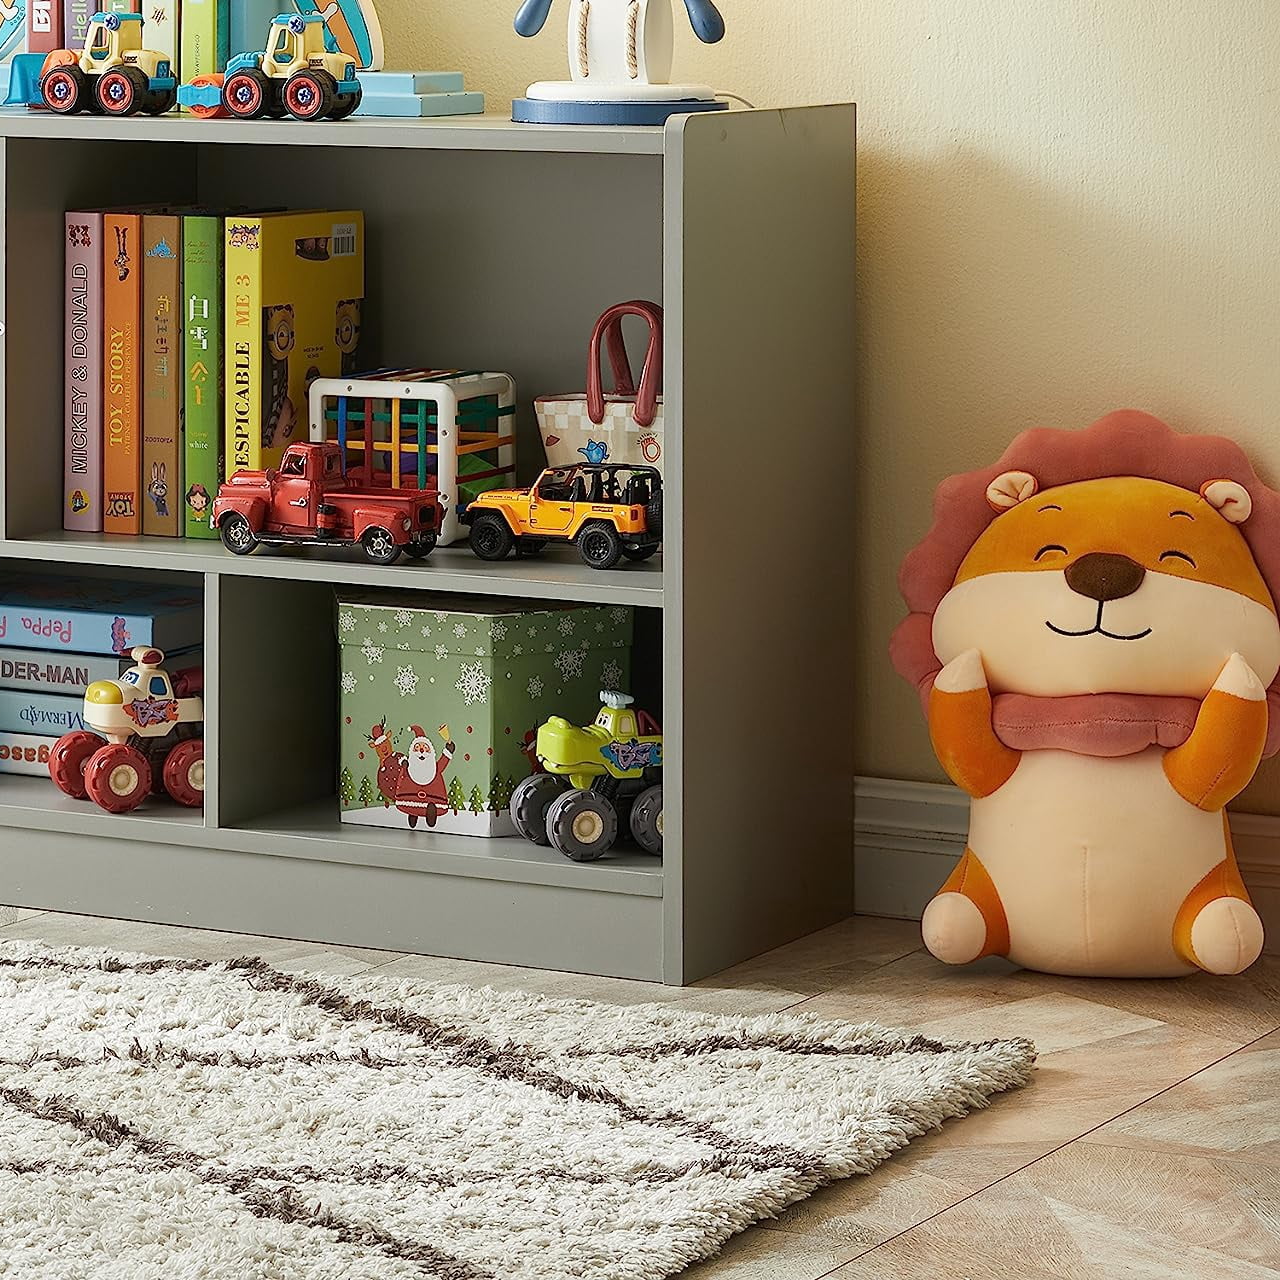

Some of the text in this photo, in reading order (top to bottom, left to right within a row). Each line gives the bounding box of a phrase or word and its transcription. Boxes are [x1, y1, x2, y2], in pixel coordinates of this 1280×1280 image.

[71, 263, 88, 474] MICKEY & DONALD
[109, 327, 125, 447] TOY STORY
[234, 273, 251, 468] ESPICABLE ME 3
[188, 440, 209, 449] white
[106, 500, 135, 517] TOY
[21, 616, 73, 644] Peppa
